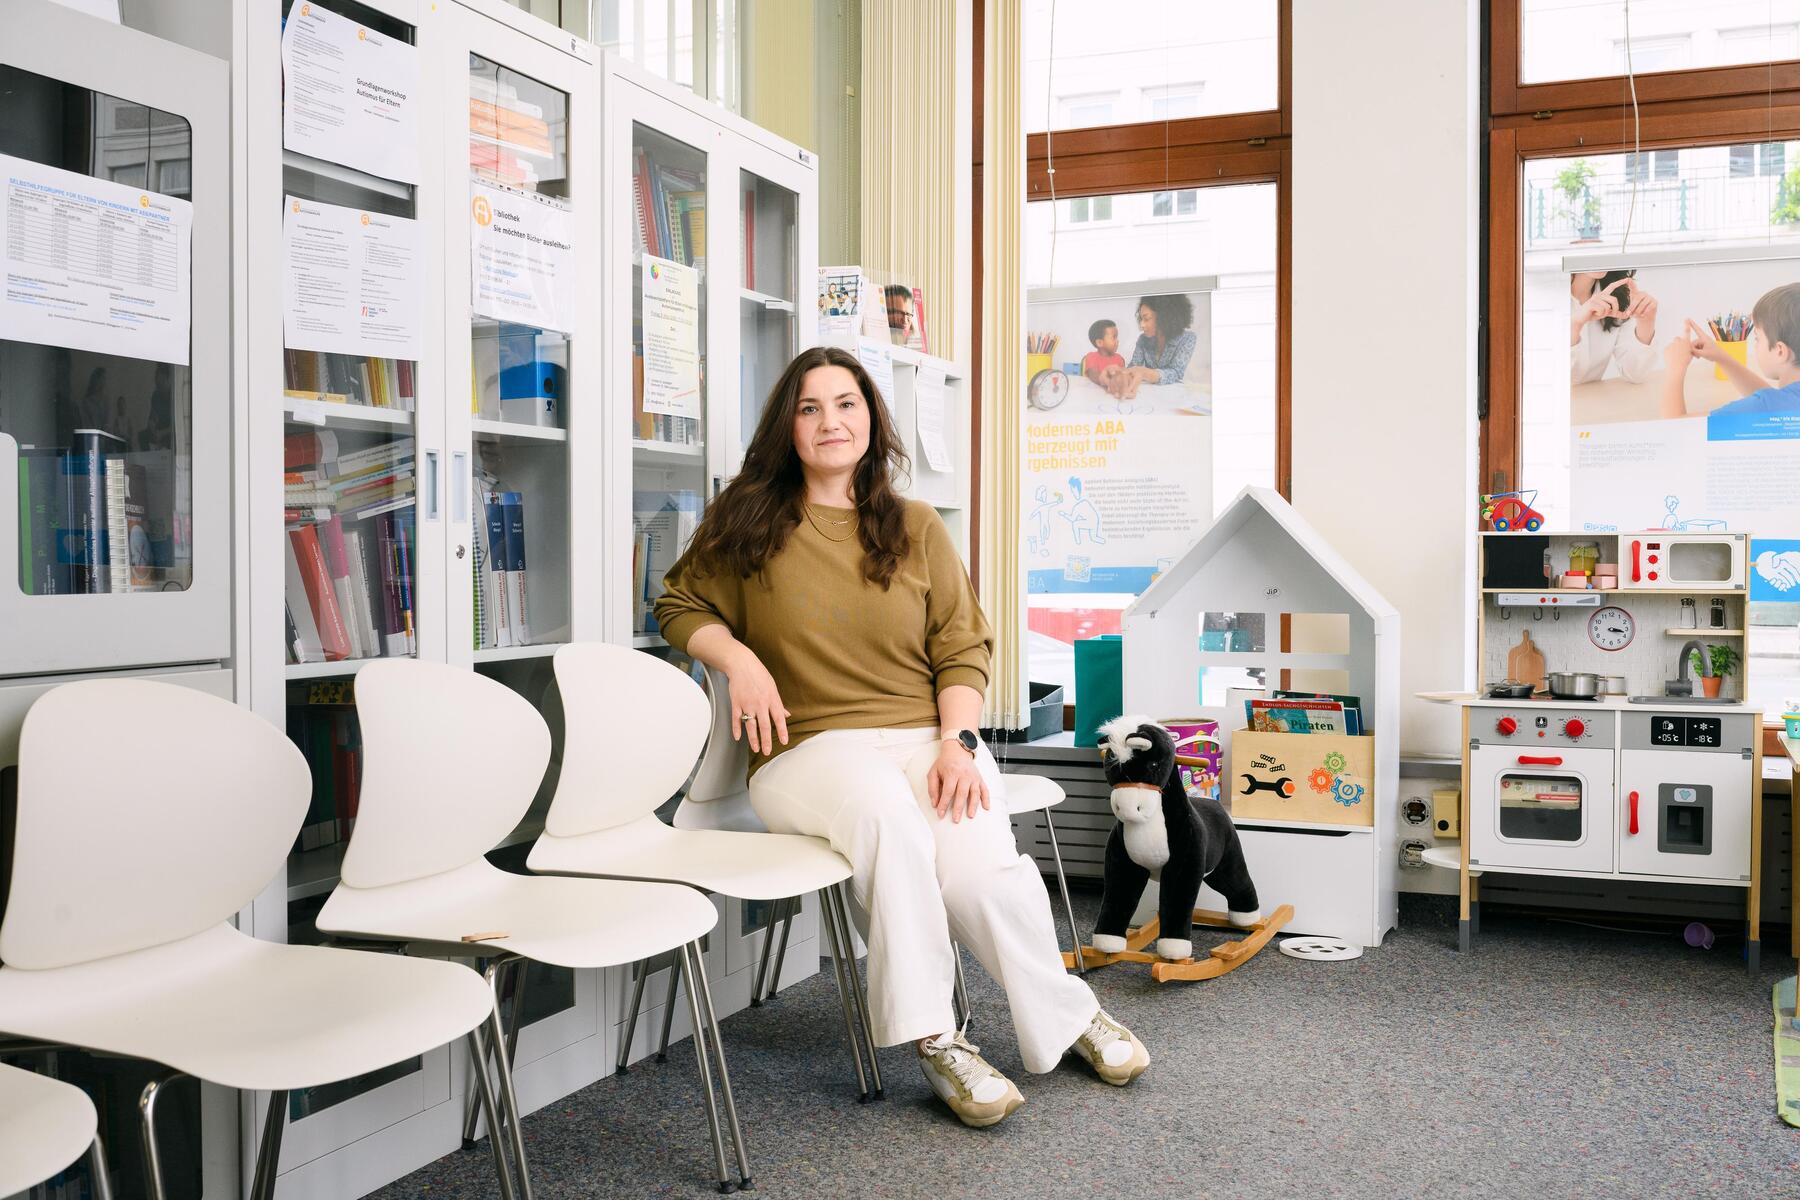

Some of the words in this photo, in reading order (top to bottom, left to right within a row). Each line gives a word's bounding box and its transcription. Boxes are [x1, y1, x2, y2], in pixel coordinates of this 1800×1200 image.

[356, 77, 407, 100] Grundlagenworkshop
[356, 88, 378, 101] Autismus
[378, 95, 386, 103] für
[386, 98, 401, 108] Eltern
[77, 193, 97, 204] ELTERN
[97, 198, 108, 207] VON
[493, 224, 502, 233] Sie
[502, 226, 526, 238] möchten
[1095, 419, 1126, 434] ABA
[1028, 438, 1091, 454] berzeugt
[1095, 438, 1119, 451] mit
[1028, 455, 1106, 472] rgebnissen
[1291, 719, 1334, 731] Piraten
